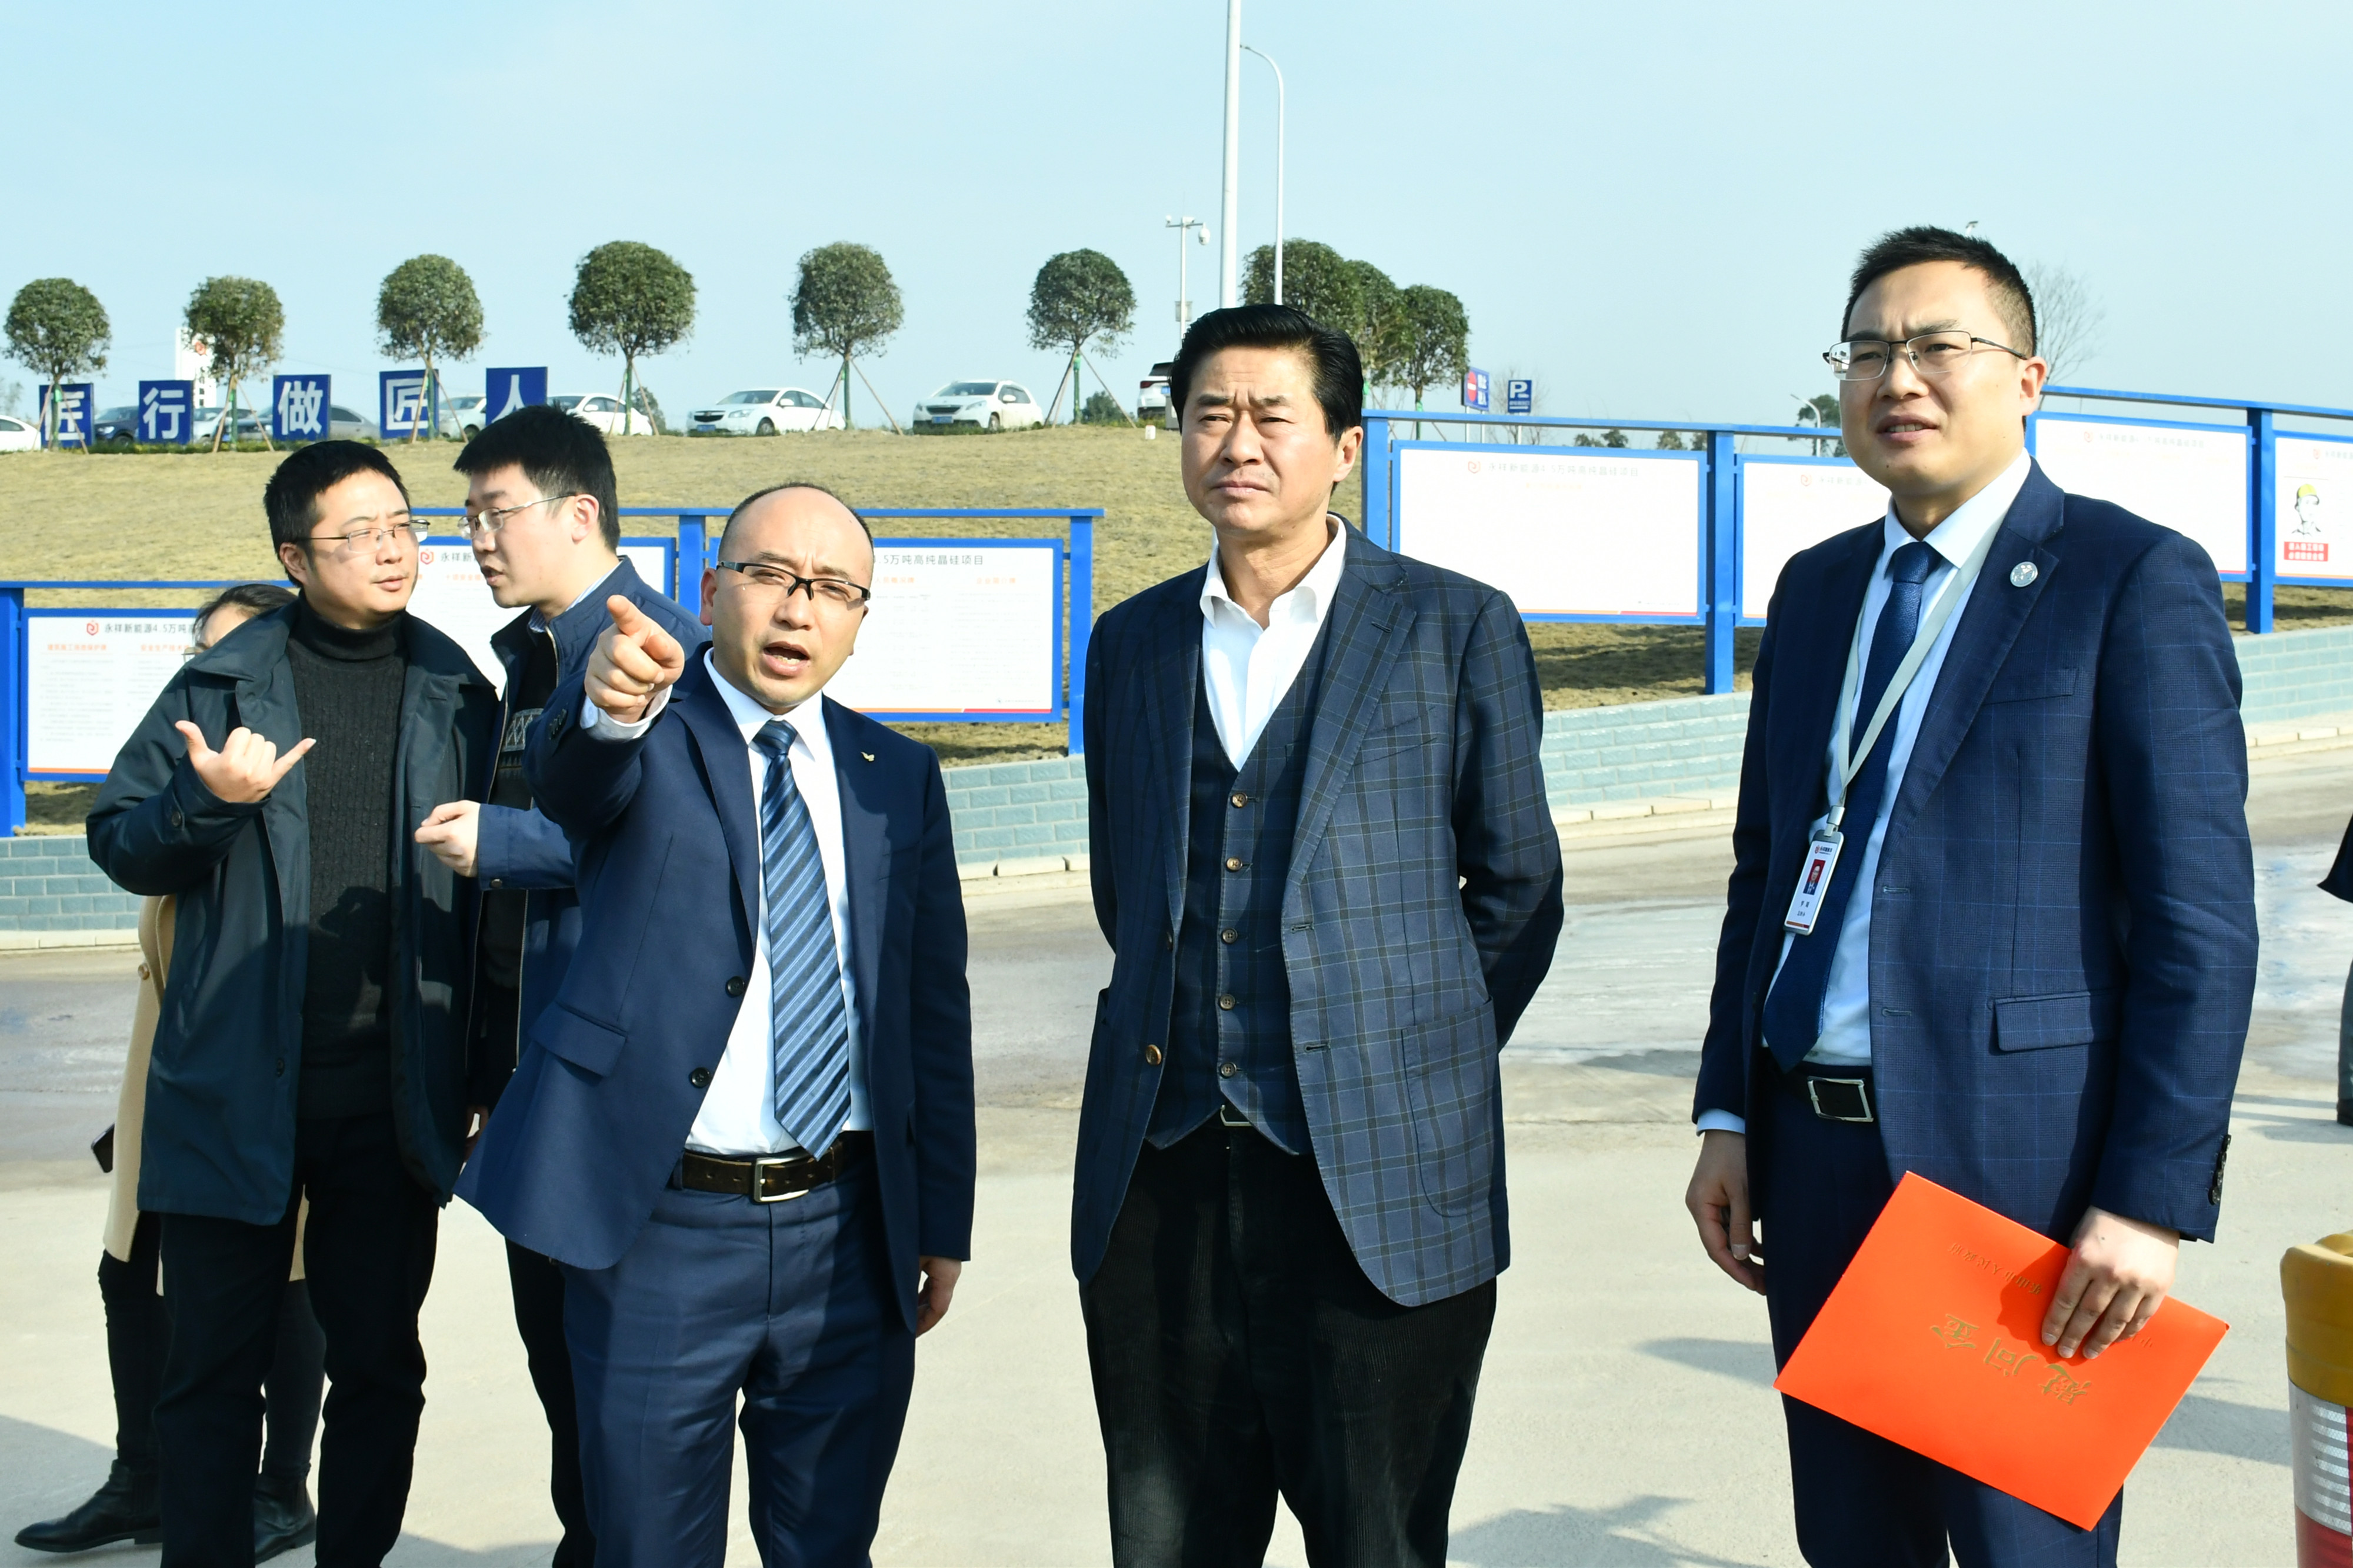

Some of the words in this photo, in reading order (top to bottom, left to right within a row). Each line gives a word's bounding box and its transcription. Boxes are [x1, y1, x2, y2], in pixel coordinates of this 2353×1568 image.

[1509, 381, 1528, 399] P
[1488, 462, 1638, 477] 永祥新能源45万吨高纯晶硅项目
[441, 552, 477, 562] 永祥新
[874, 555, 984, 565] .5万吨高纯晶硅项目
[1947, 1241, 2043, 1296] 乐山市人民政府
[1929, 1313, 2092, 1407] 慰问金
